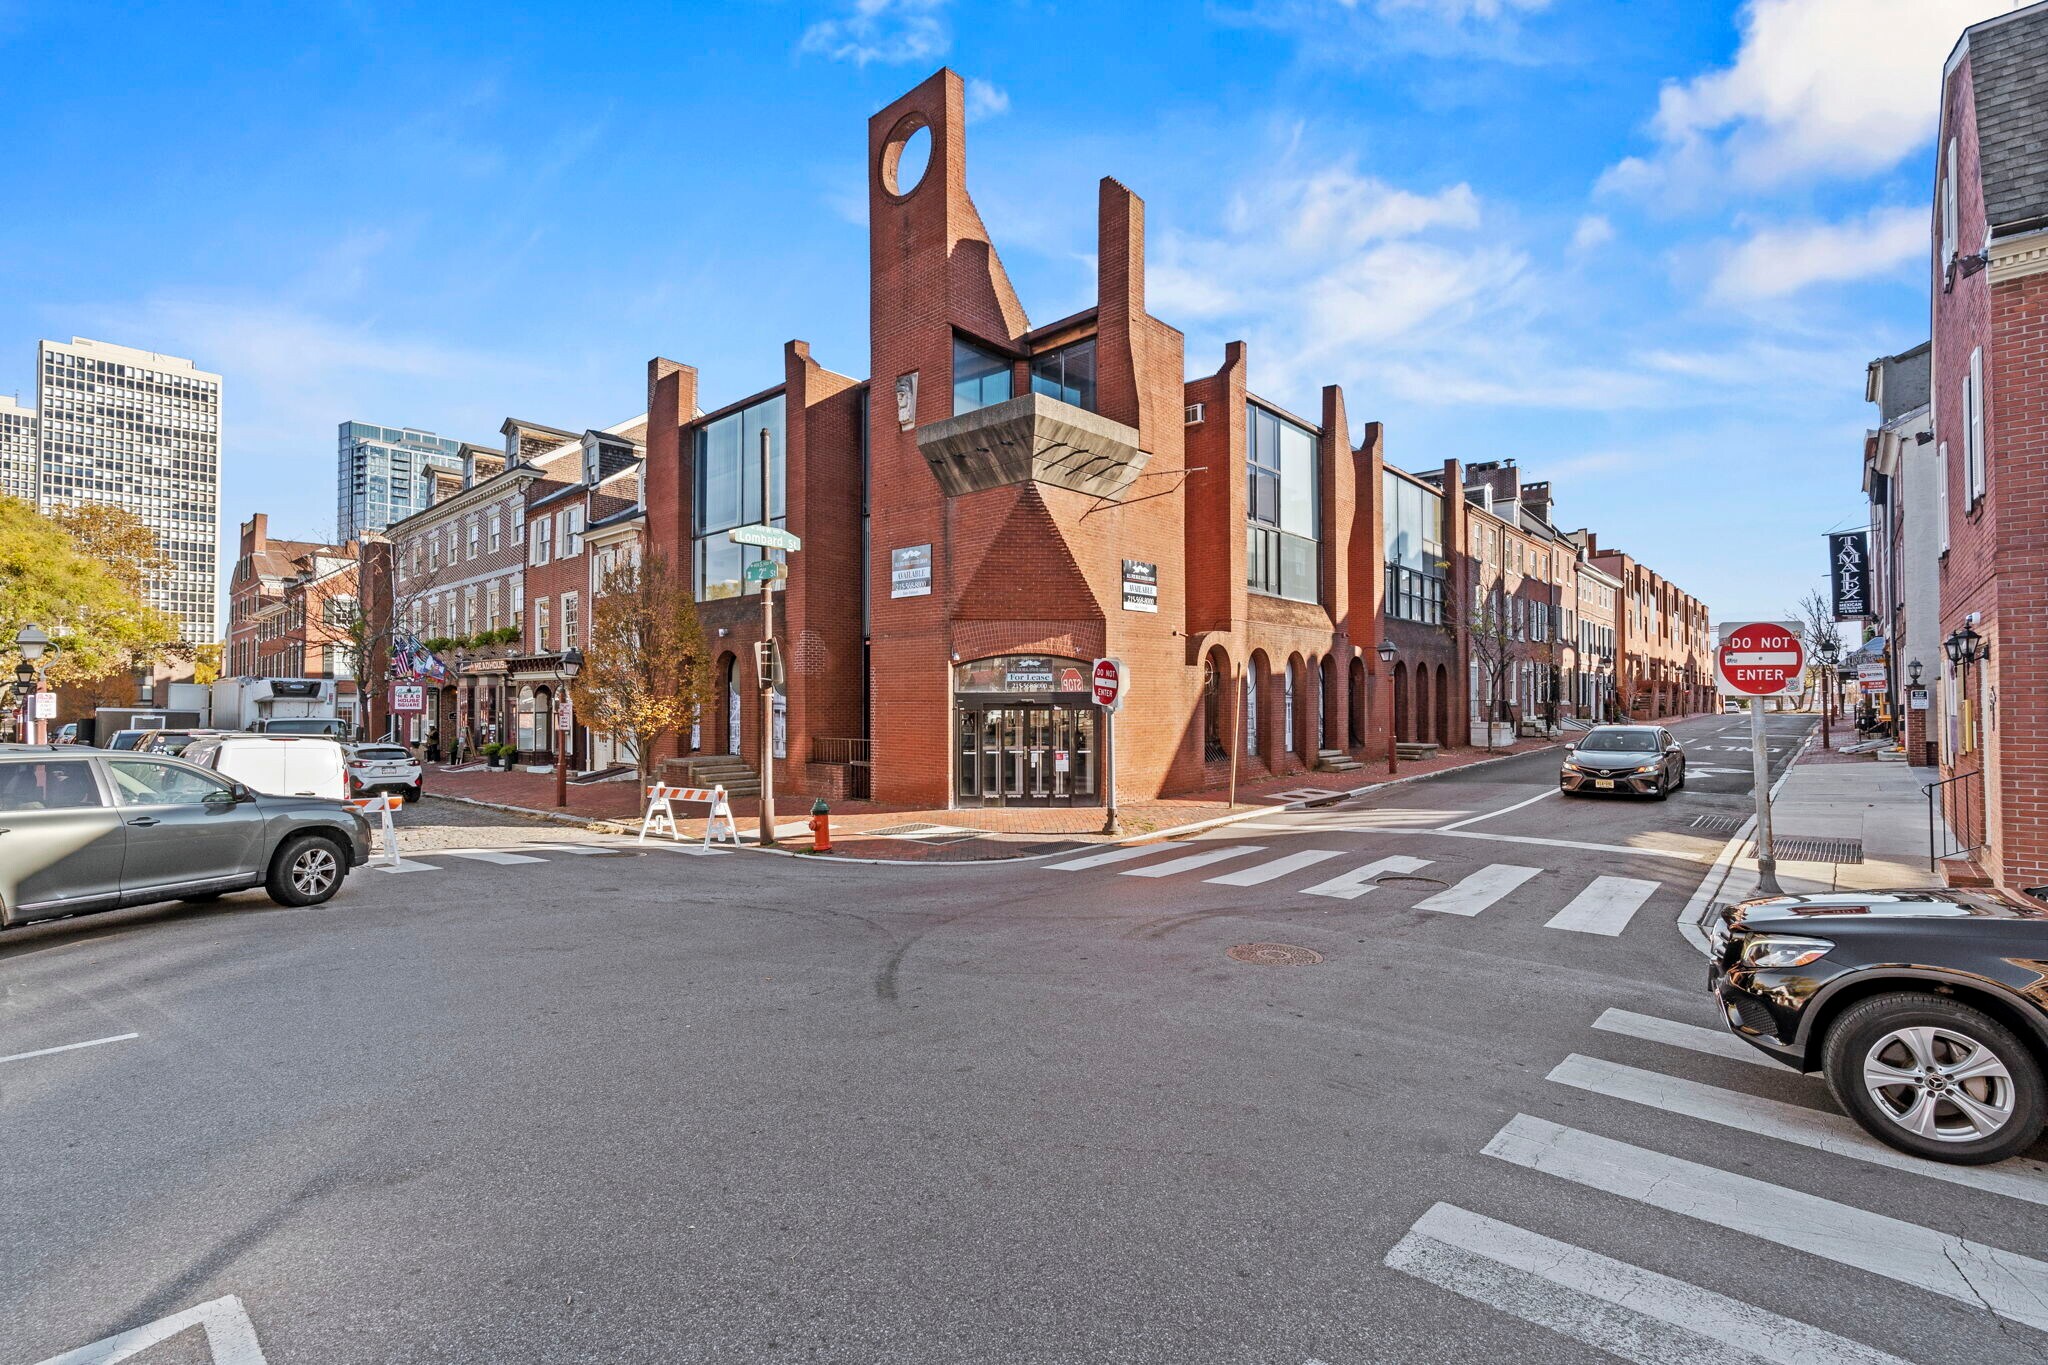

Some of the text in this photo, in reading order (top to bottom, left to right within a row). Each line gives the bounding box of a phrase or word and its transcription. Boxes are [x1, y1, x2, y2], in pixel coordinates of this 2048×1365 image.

[739, 530, 797, 549] Lombard St
[1837, 535, 1861, 600] TAMALEX
[896, 568, 926, 580] AVAILABLE
[1128, 583, 1153, 594] AVAILABLE
[1732, 636, 1790, 649] DO NOT
[1097, 668, 1115, 677] DO NOT
[1737, 669, 1784, 681] ENTER
[1097, 688, 1113, 698] ENTER
